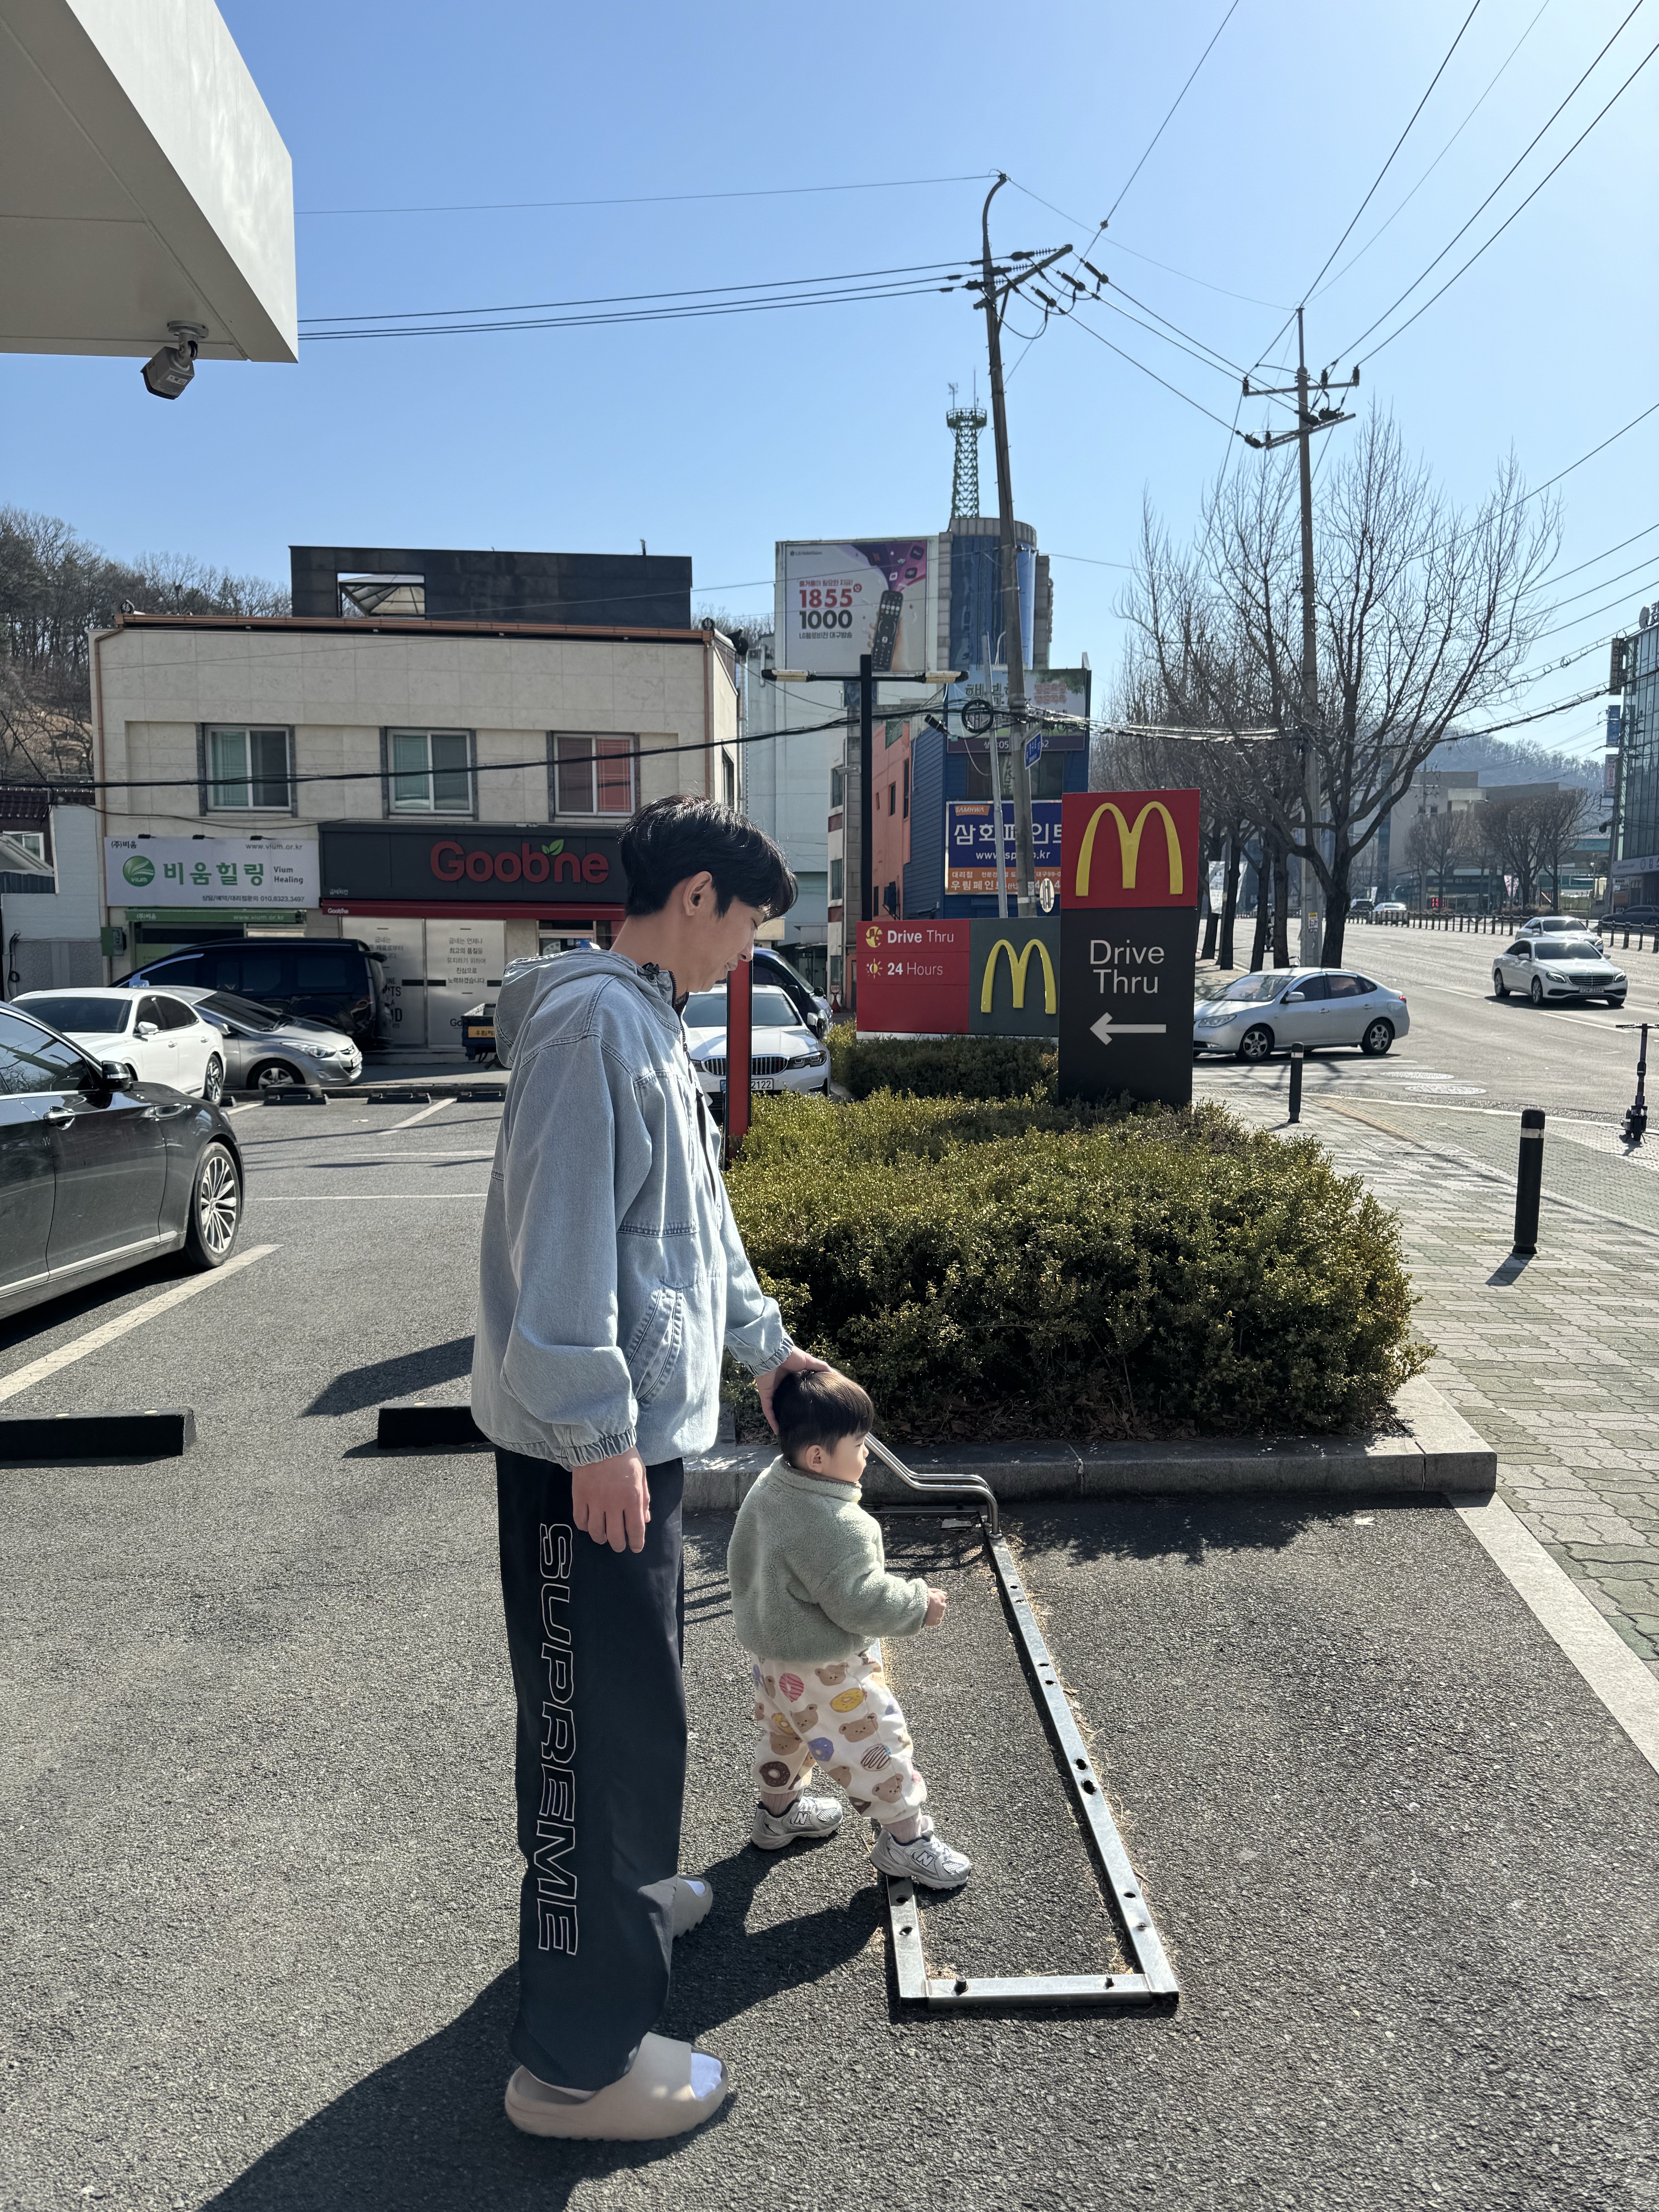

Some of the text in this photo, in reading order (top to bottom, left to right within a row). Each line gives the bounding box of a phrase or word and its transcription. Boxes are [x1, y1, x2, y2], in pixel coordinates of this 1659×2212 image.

[799, 589, 853, 608] 1855
[799, 610, 853, 630] 1000
[111, 840, 137, 849] (주)비움
[430, 840, 609, 884] Goobne
[163, 862, 264, 886] 비움힐링
[274, 876, 303, 885] Healing
[887, 930, 954, 943] Drive Thru
[1090, 939, 1165, 965] Drive
[887, 962, 943, 975] 24 Hours
[1093, 969, 1159, 994] Thru
[751, 1081, 771, 1090] 2122
[534, 1523, 579, 1956] SUPREME
[794, 1812, 808, 1825] N
[917, 1851, 934, 1867] N
